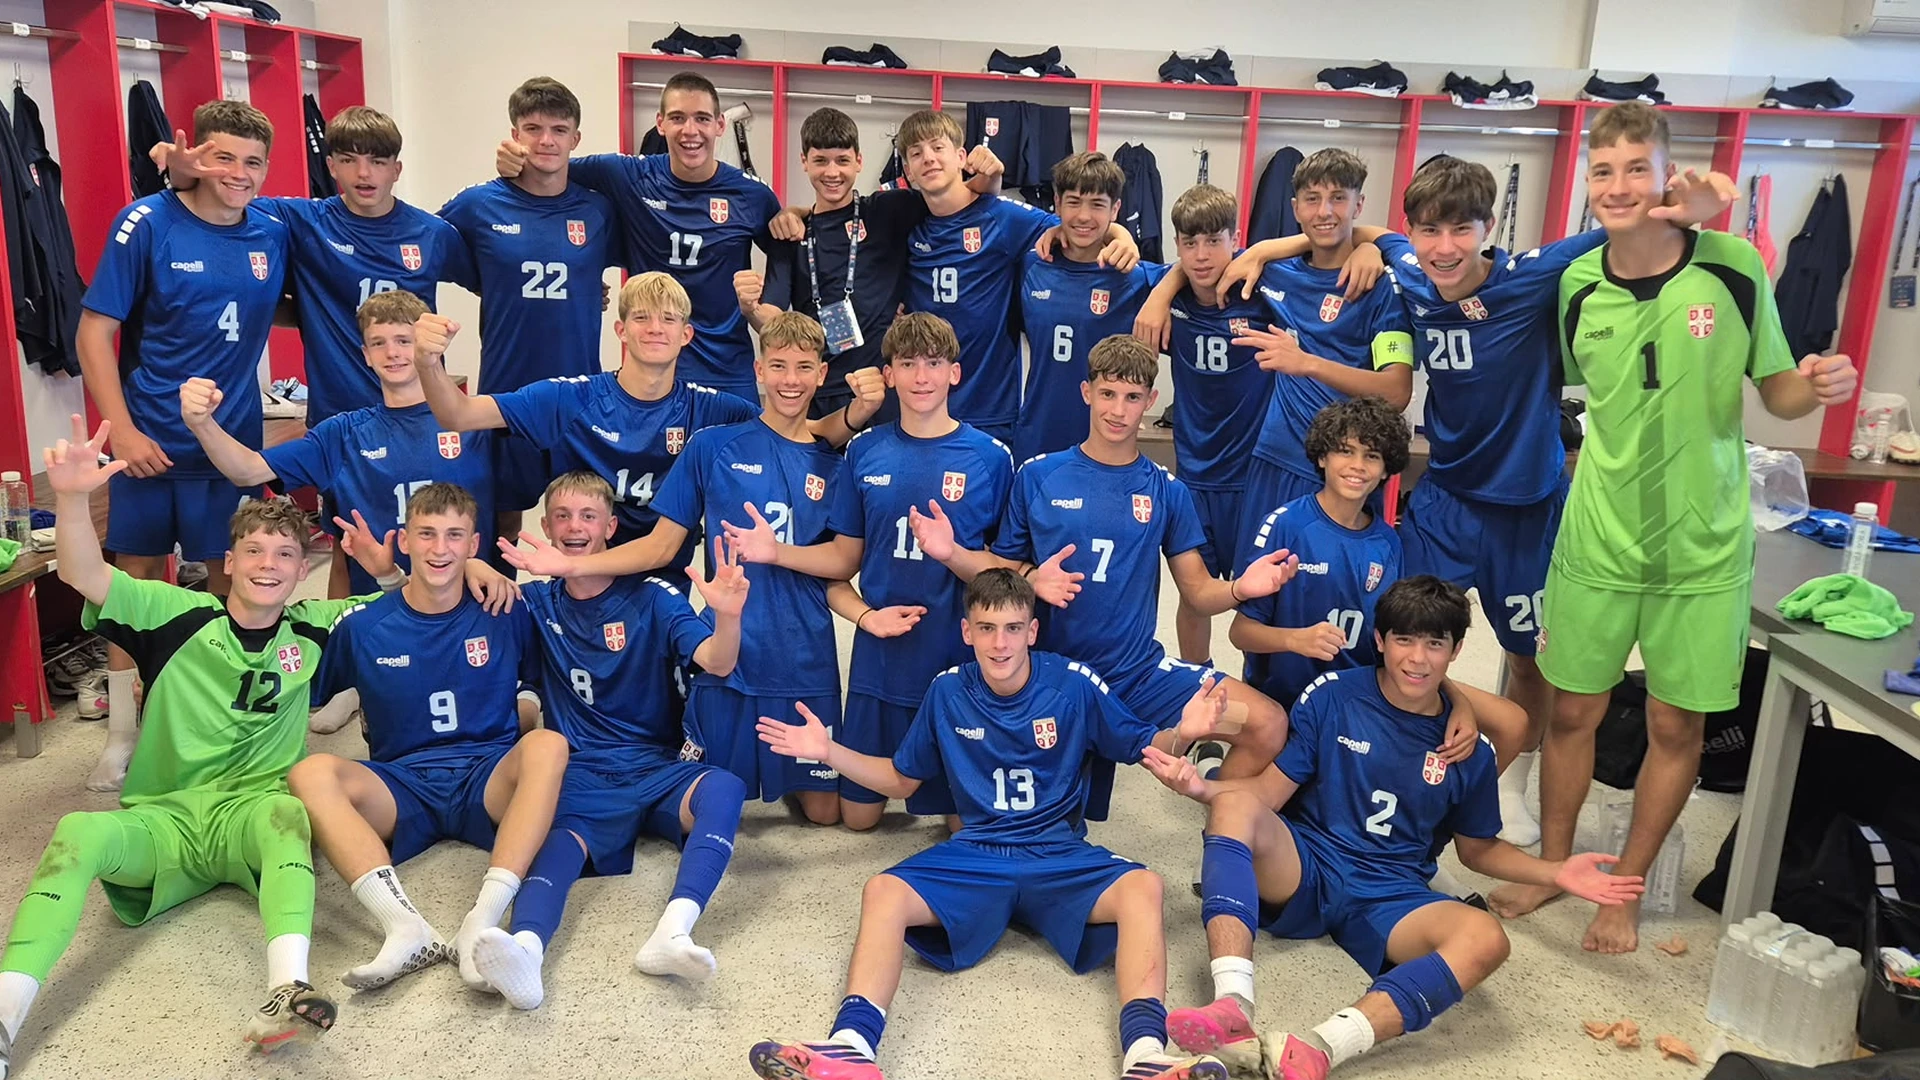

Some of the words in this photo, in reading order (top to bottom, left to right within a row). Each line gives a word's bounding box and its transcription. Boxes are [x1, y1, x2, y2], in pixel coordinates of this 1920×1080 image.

[171, 261, 203, 272] capelli
[669, 231, 703, 265] 17
[521, 261, 568, 299] 22
[932, 267, 958, 303] 19
[217, 301, 239, 341] 4
[1053, 325, 1073, 362] 6
[1195, 335, 1228, 372] 18
[1426, 328, 1473, 370] 20
[1640, 341, 1661, 390] 1
[394, 480, 433, 524] 1
[615, 468, 654, 506] 14
[1051, 499, 1082, 509] capelli
[1091, 538, 1115, 583] 7
[376, 655, 410, 667] capelli
[230, 669, 282, 714] 12
[570, 667, 594, 706] 8
[428, 690, 458, 733] 9
[1337, 736, 1370, 754] capelli
[992, 768, 1035, 811] 13
[1365, 789, 1398, 837] 2
